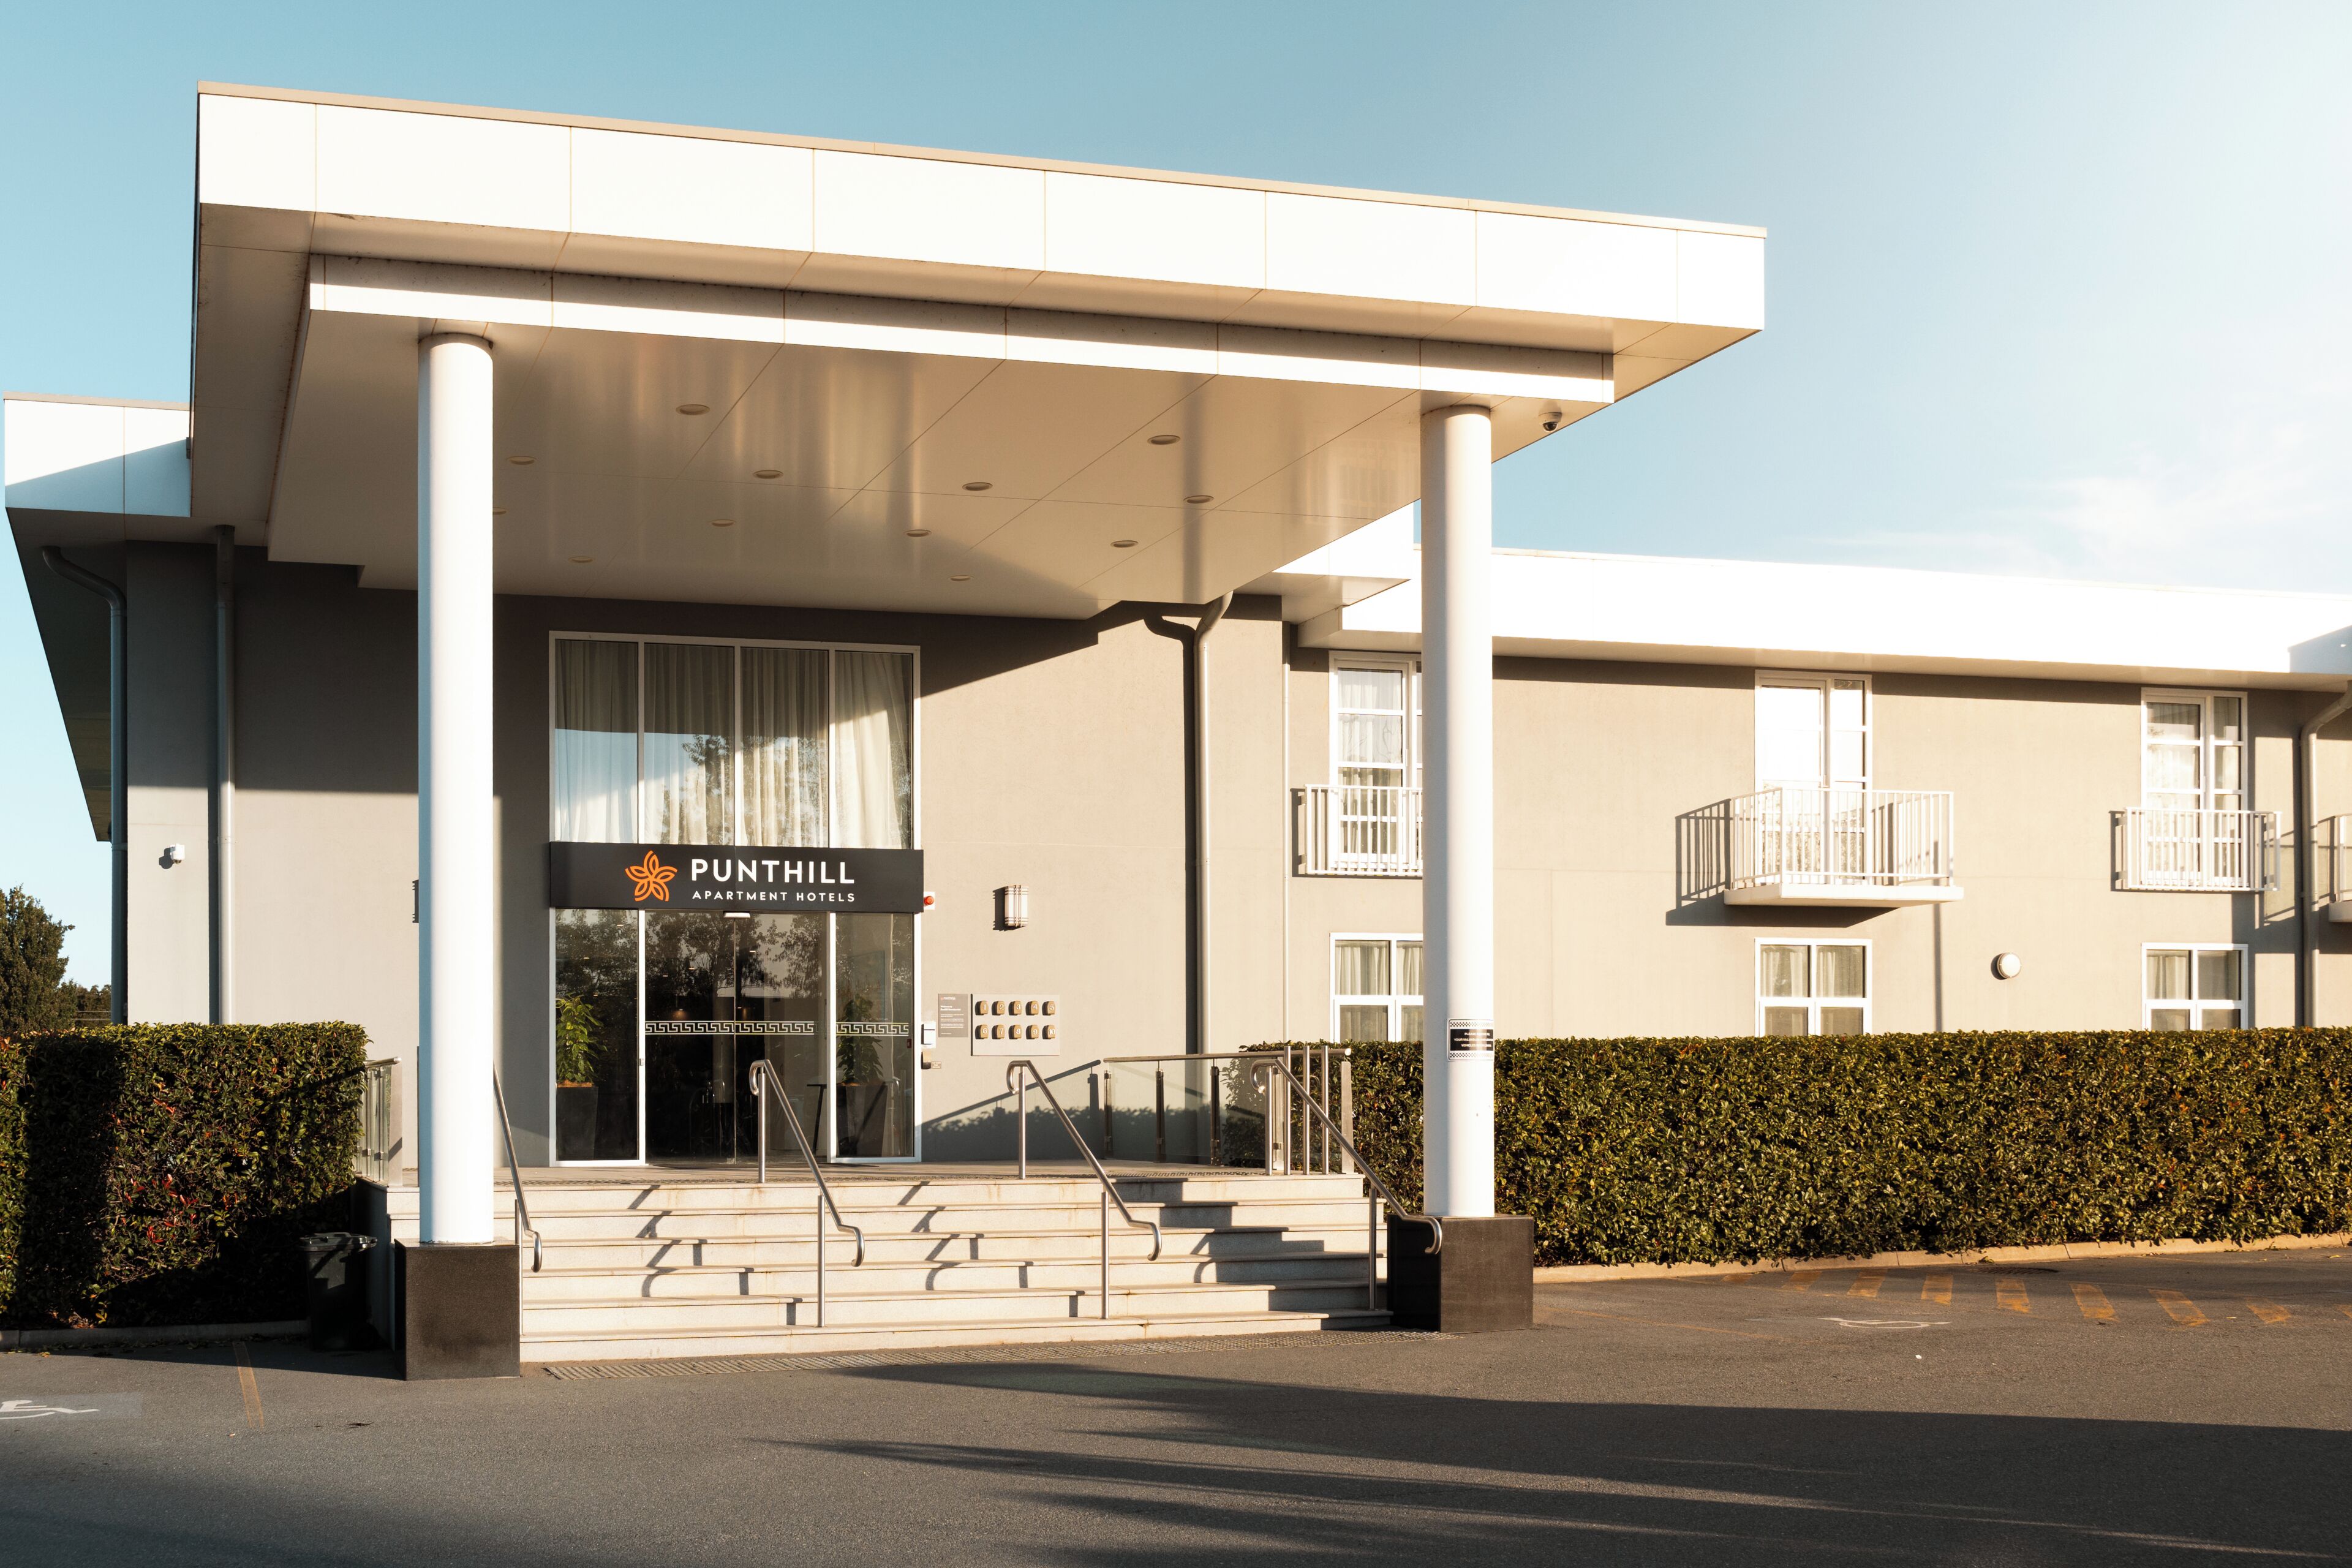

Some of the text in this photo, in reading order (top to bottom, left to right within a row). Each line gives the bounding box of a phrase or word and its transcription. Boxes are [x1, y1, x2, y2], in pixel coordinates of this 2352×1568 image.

[692, 858, 855, 884] PUNTHILL
[692, 890, 855, 902] APARTMENT HOTELS
